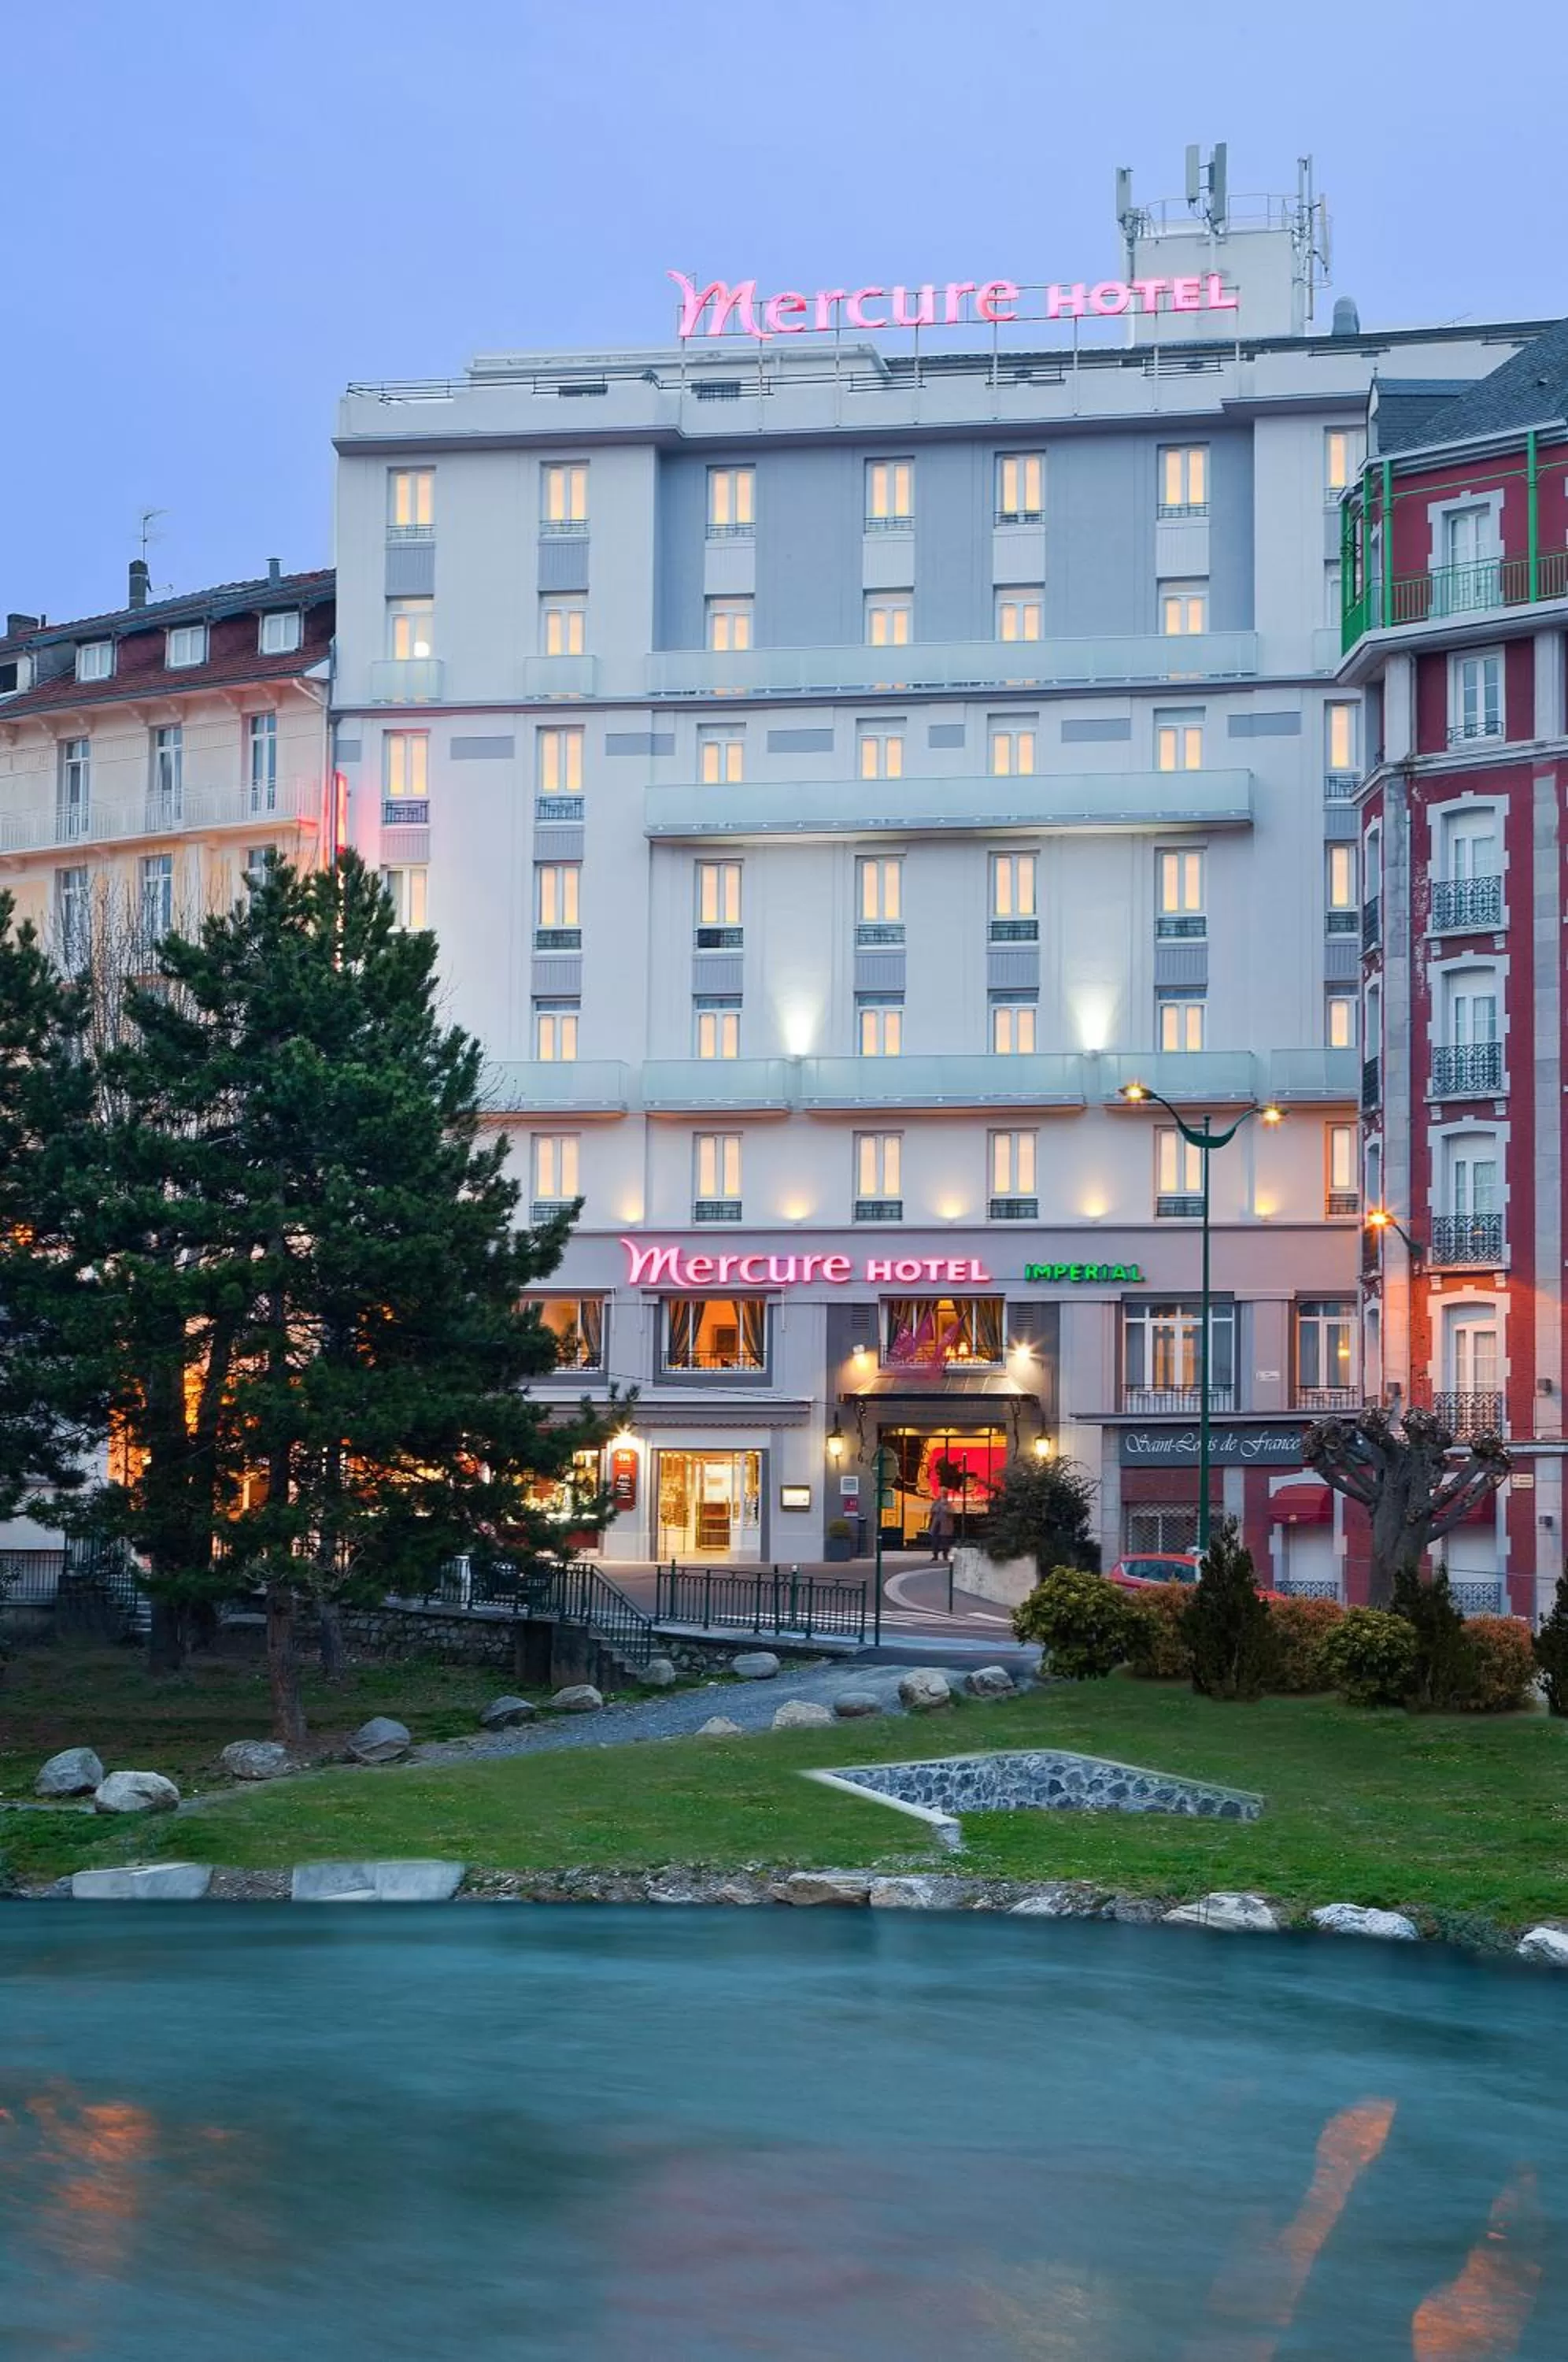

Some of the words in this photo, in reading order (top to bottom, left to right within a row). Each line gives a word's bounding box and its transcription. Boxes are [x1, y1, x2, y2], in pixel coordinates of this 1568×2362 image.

[666, 270, 1018, 341] Mercure
[1047, 273, 1238, 318] HOTEL
[620, 1238, 852, 1287] Mercure
[866, 1259, 991, 1283] HOTEL
[1025, 1262, 1145, 1282] IMPERIAL
[1126, 1432, 1218, 1453] Saint-Lois
[1219, 1433, 1238, 1451] de
[1240, 1431, 1301, 1457] France
